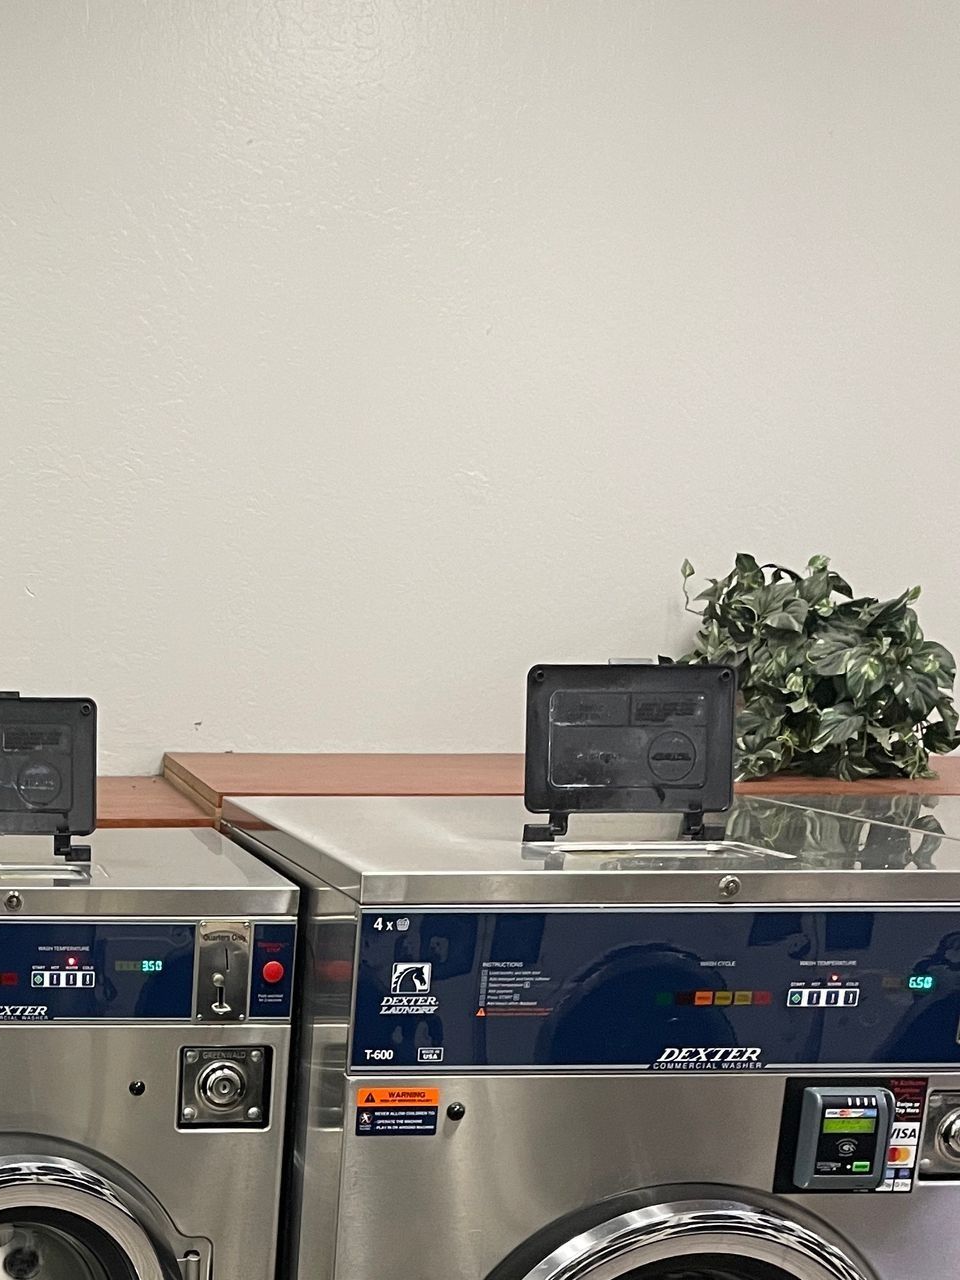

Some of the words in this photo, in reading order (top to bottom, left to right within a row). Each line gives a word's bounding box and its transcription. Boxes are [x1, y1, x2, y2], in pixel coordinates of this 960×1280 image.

[373, 917, 383, 931] 4
[385, 921, 394, 931] x
[203, 933, 231, 942] Quarters
[380, 996, 437, 1006] DEXTER
[379, 1006, 439, 1015] LAUNDRY
[364, 1049, 394, 1060] T-600
[656, 1047, 762, 1062] DEXTER
[652, 1062, 719, 1070] COMMERCIAL
[721, 1062, 763, 1070] WASHER
[388, 1091, 426, 1099] WARNING
